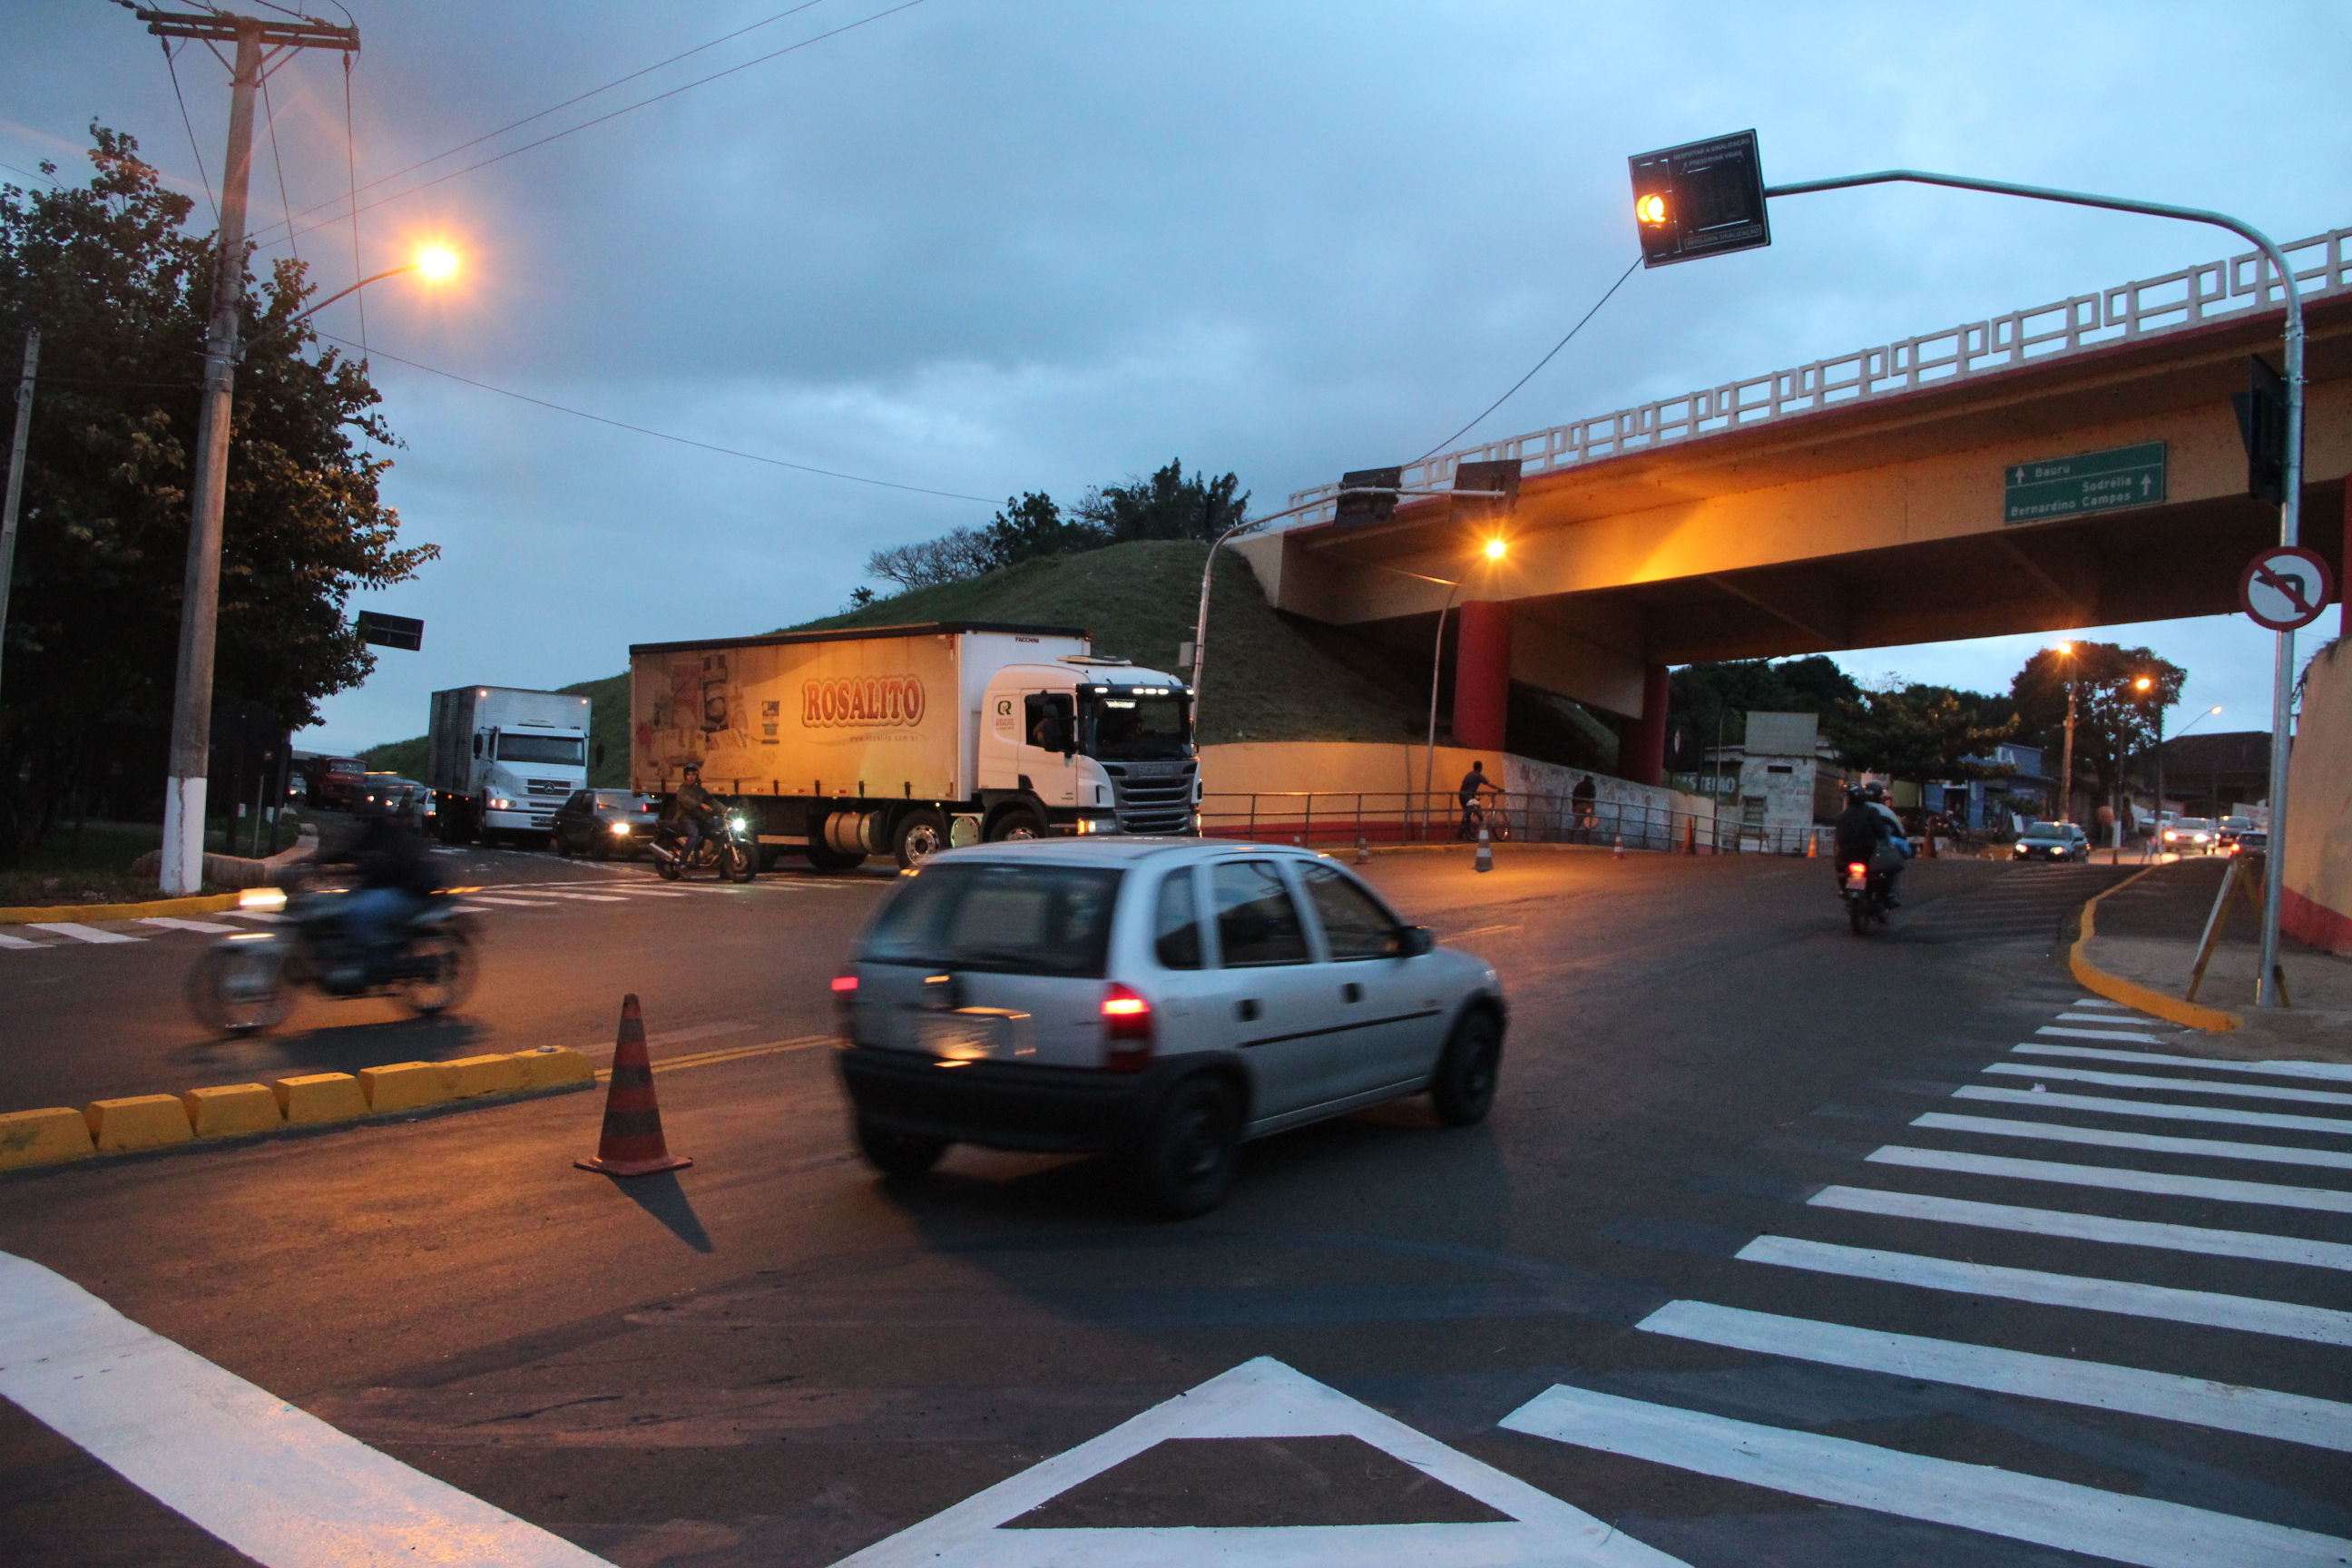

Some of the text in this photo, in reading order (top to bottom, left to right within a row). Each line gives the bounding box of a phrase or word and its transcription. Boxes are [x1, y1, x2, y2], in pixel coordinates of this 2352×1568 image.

[2035, 465, 2071, 478] Bauru
[2011, 492, 2131, 517] Bernardino Campos
[806, 680, 920, 720] ROSALITO
